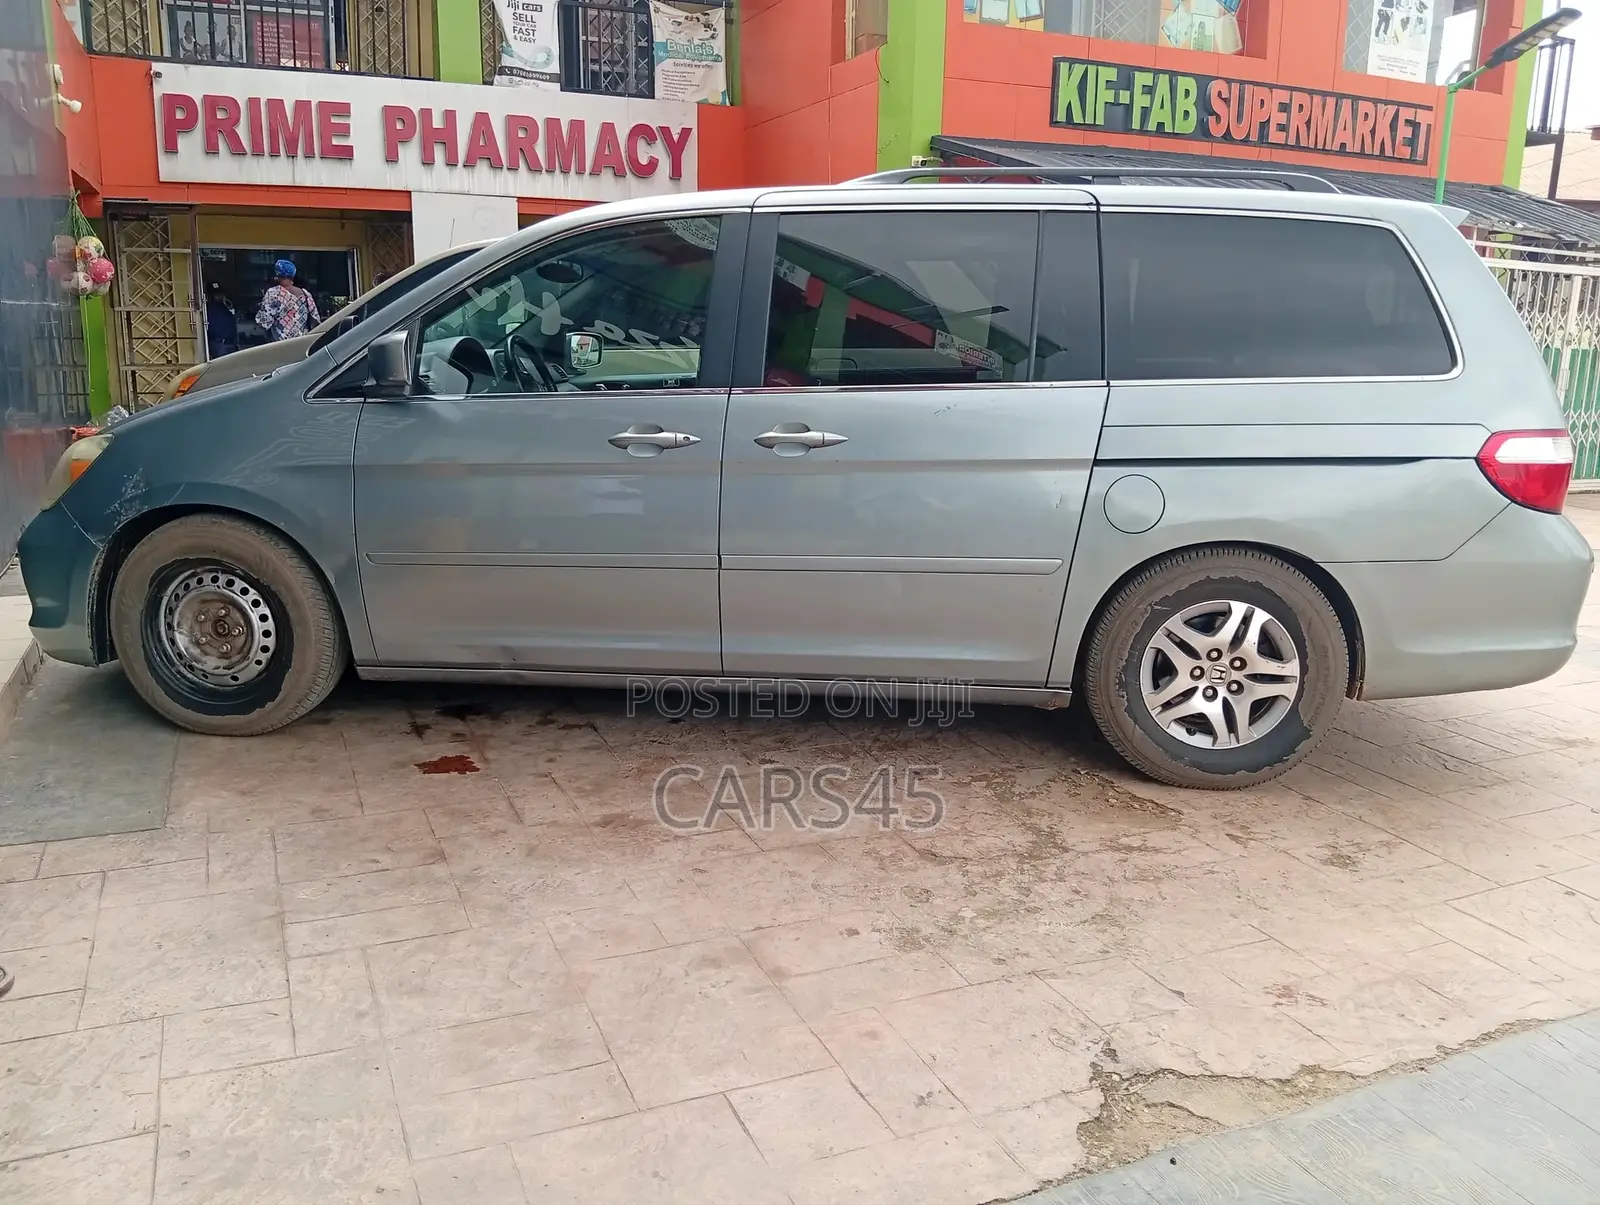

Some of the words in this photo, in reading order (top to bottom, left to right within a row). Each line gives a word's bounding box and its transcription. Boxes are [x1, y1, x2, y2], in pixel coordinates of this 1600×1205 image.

[523, 4, 542, 12] cars
[512, 12, 536, 24] SELL
[512, 26, 537, 37] FAST
[519, 35, 537, 44] EASY
[1055, 61, 1199, 135] KIF-FAB
[1205, 78, 1433, 161] SUPERMARKET
[161, 92, 354, 160] PRIME
[382, 104, 693, 180] PHARMACY
